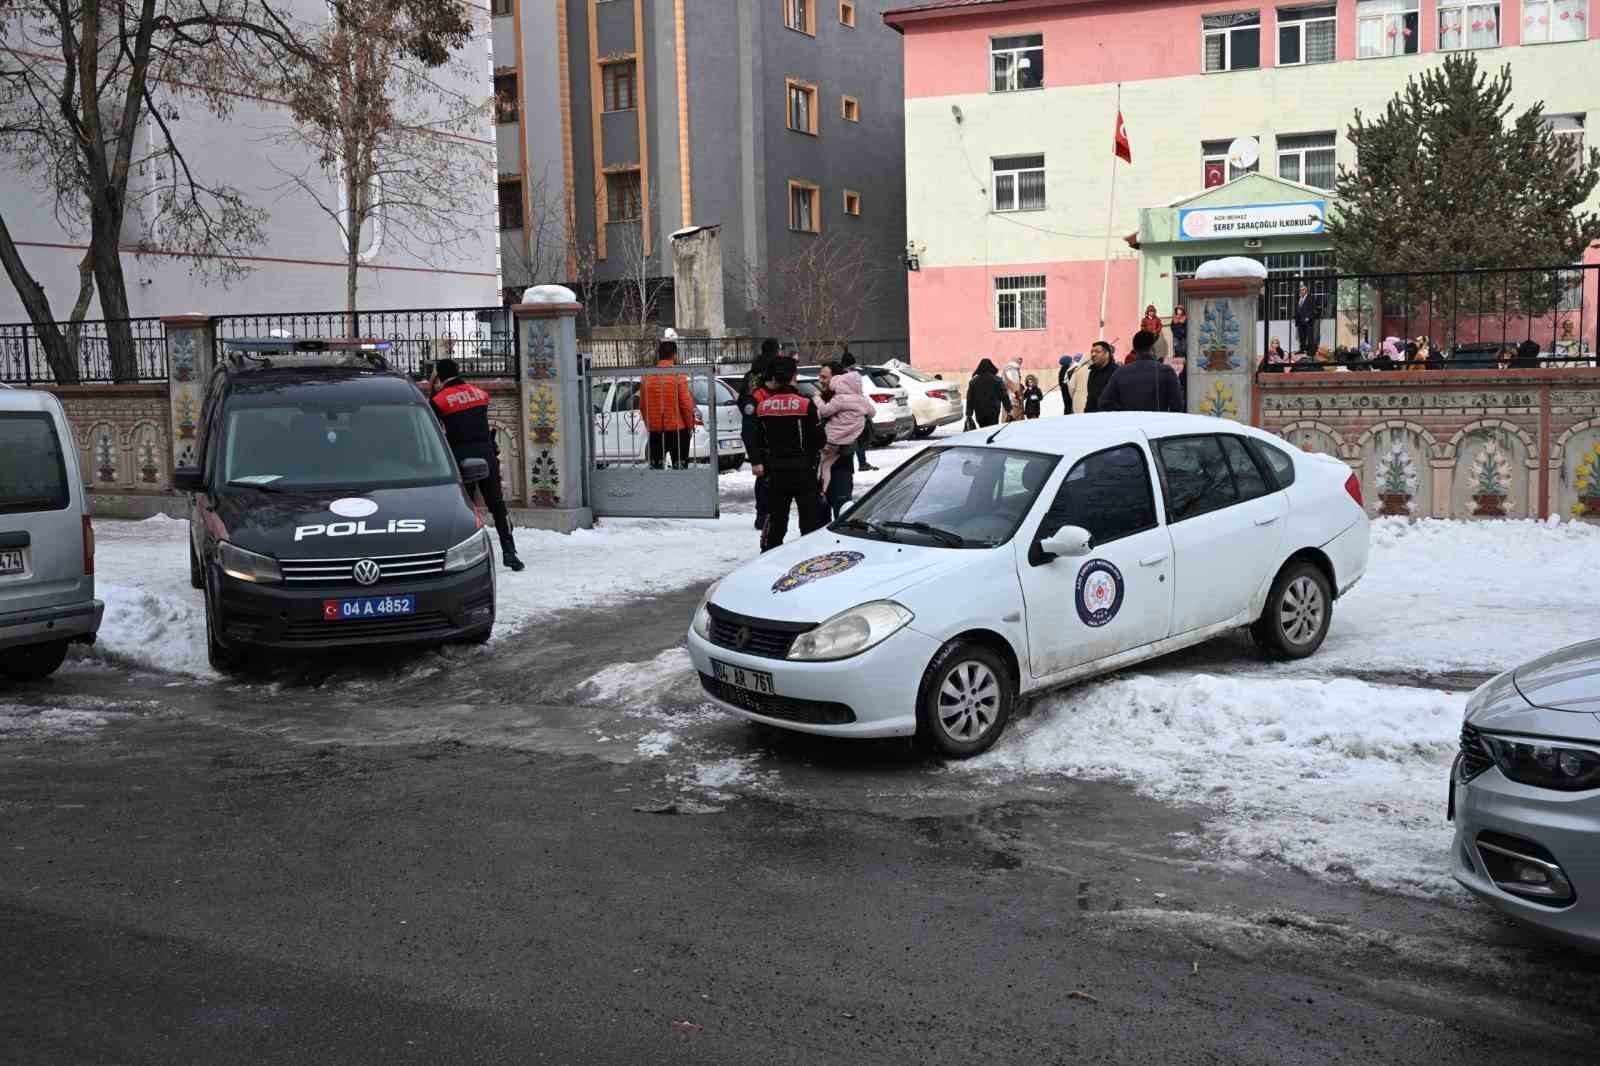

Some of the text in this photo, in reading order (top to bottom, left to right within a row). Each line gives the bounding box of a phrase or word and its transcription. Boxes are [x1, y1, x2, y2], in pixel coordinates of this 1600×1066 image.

[1213, 217, 1313, 232] ŞEREF SARAÇOĞLU İLKOKULU
[343, 598, 410, 616] 04 A 4852
